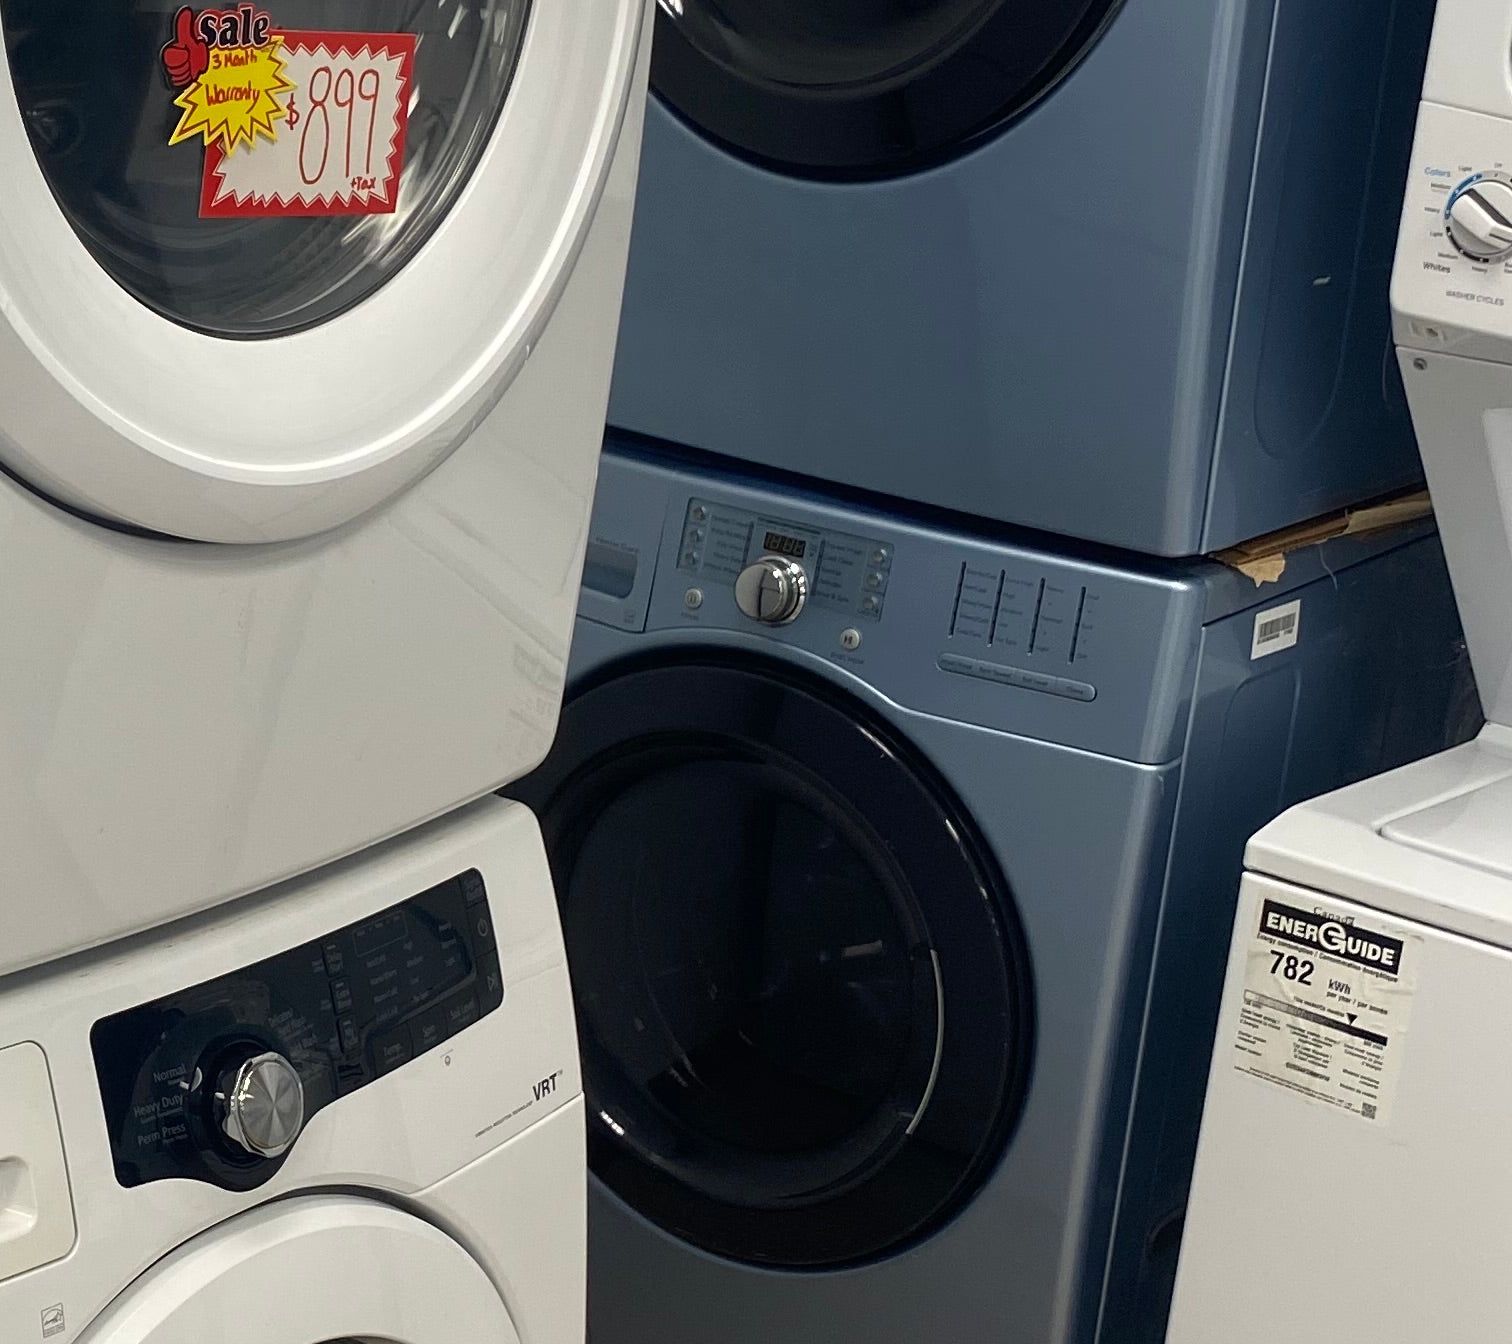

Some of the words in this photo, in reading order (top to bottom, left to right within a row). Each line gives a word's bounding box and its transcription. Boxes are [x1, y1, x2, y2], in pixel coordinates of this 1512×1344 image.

[199, 7, 270, 47] sale
[212, 56, 222, 71] 3
[224, 52, 258, 68] Month
[1424, 166, 1451, 178] Colors
[1423, 261, 1451, 274] Whites
[1476, 295, 1505, 306] CYCLES
[1266, 912, 1396, 967] ENERGUIDE
[1269, 949, 1315, 986] 782
[1328, 979, 1351, 995] kWh
[153, 1063, 186, 1083] Normal
[532, 1072, 558, 1102] VRT
[134, 1102, 161, 1118] Heavy
[161, 1094, 184, 1108] Duty
[138, 1131, 161, 1147] Perm
[161, 1123, 187, 1138] Press
